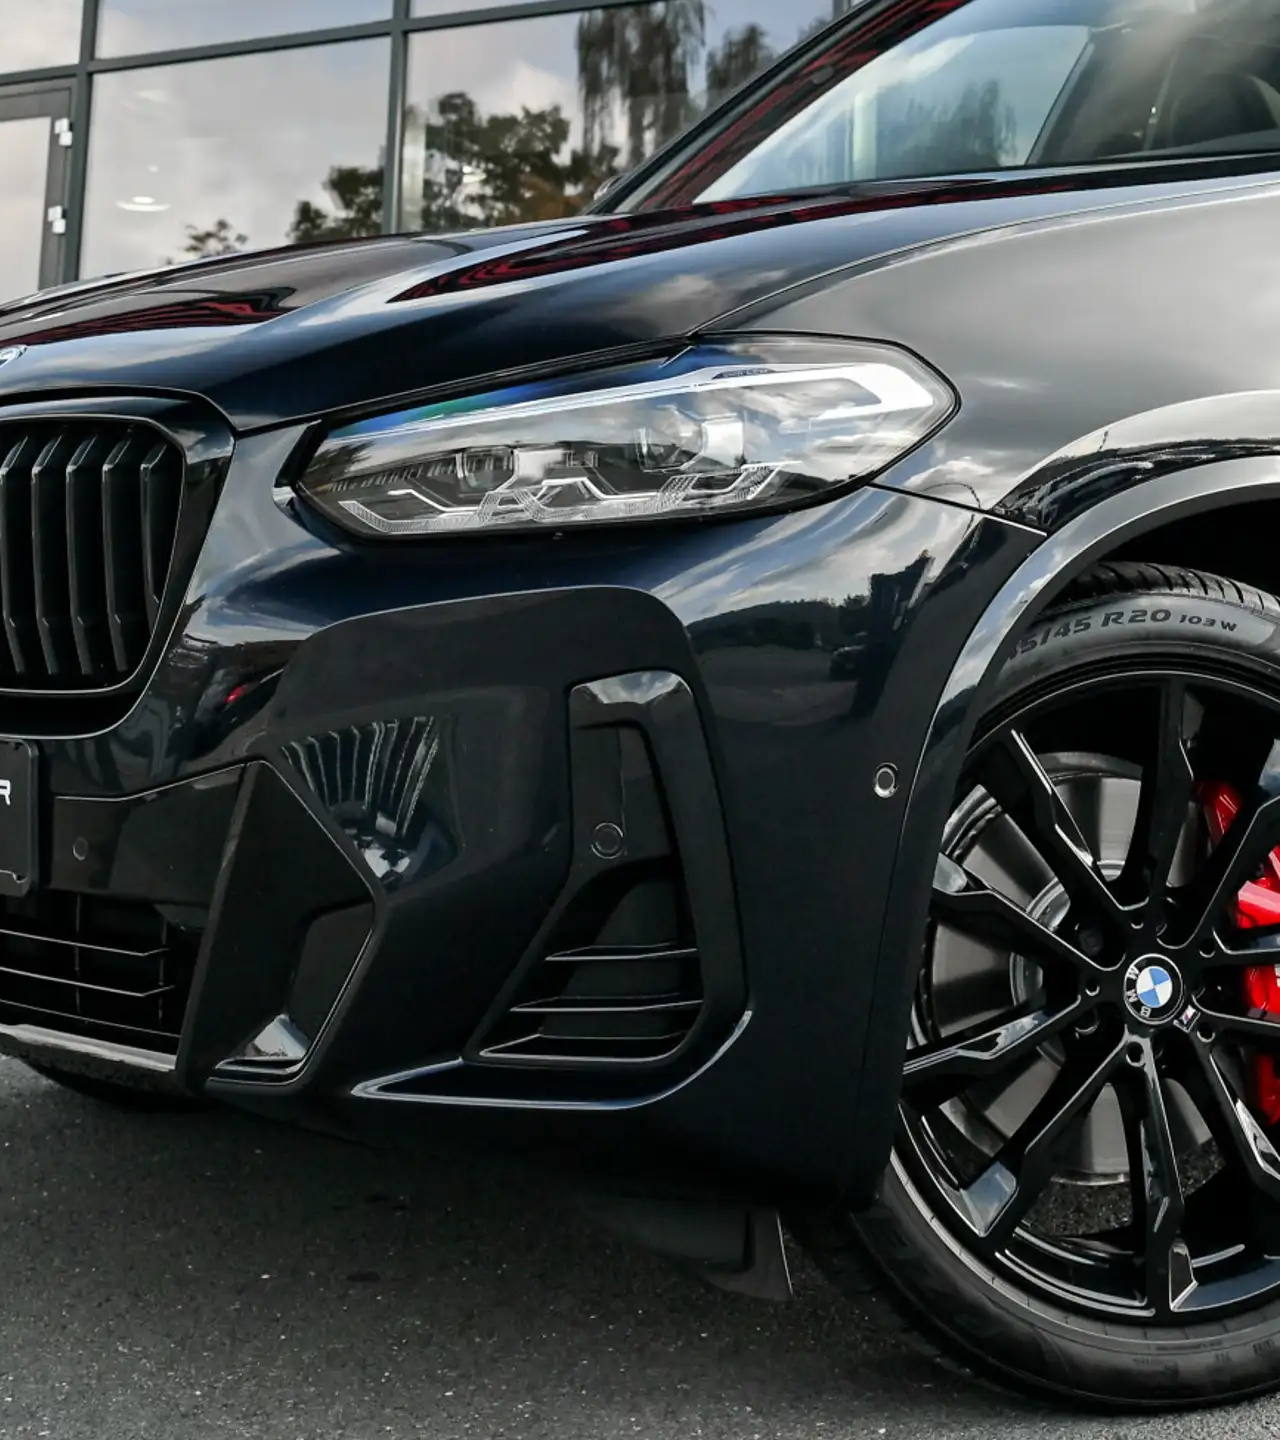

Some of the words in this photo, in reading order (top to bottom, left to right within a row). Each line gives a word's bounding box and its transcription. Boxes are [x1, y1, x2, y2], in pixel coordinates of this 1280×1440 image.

[1008, 615, 1092, 661] 5/45
[1100, 609, 1172, 629] R20
[1179, 614, 1216, 627] 103
[1221, 620, 1238, 632] W
